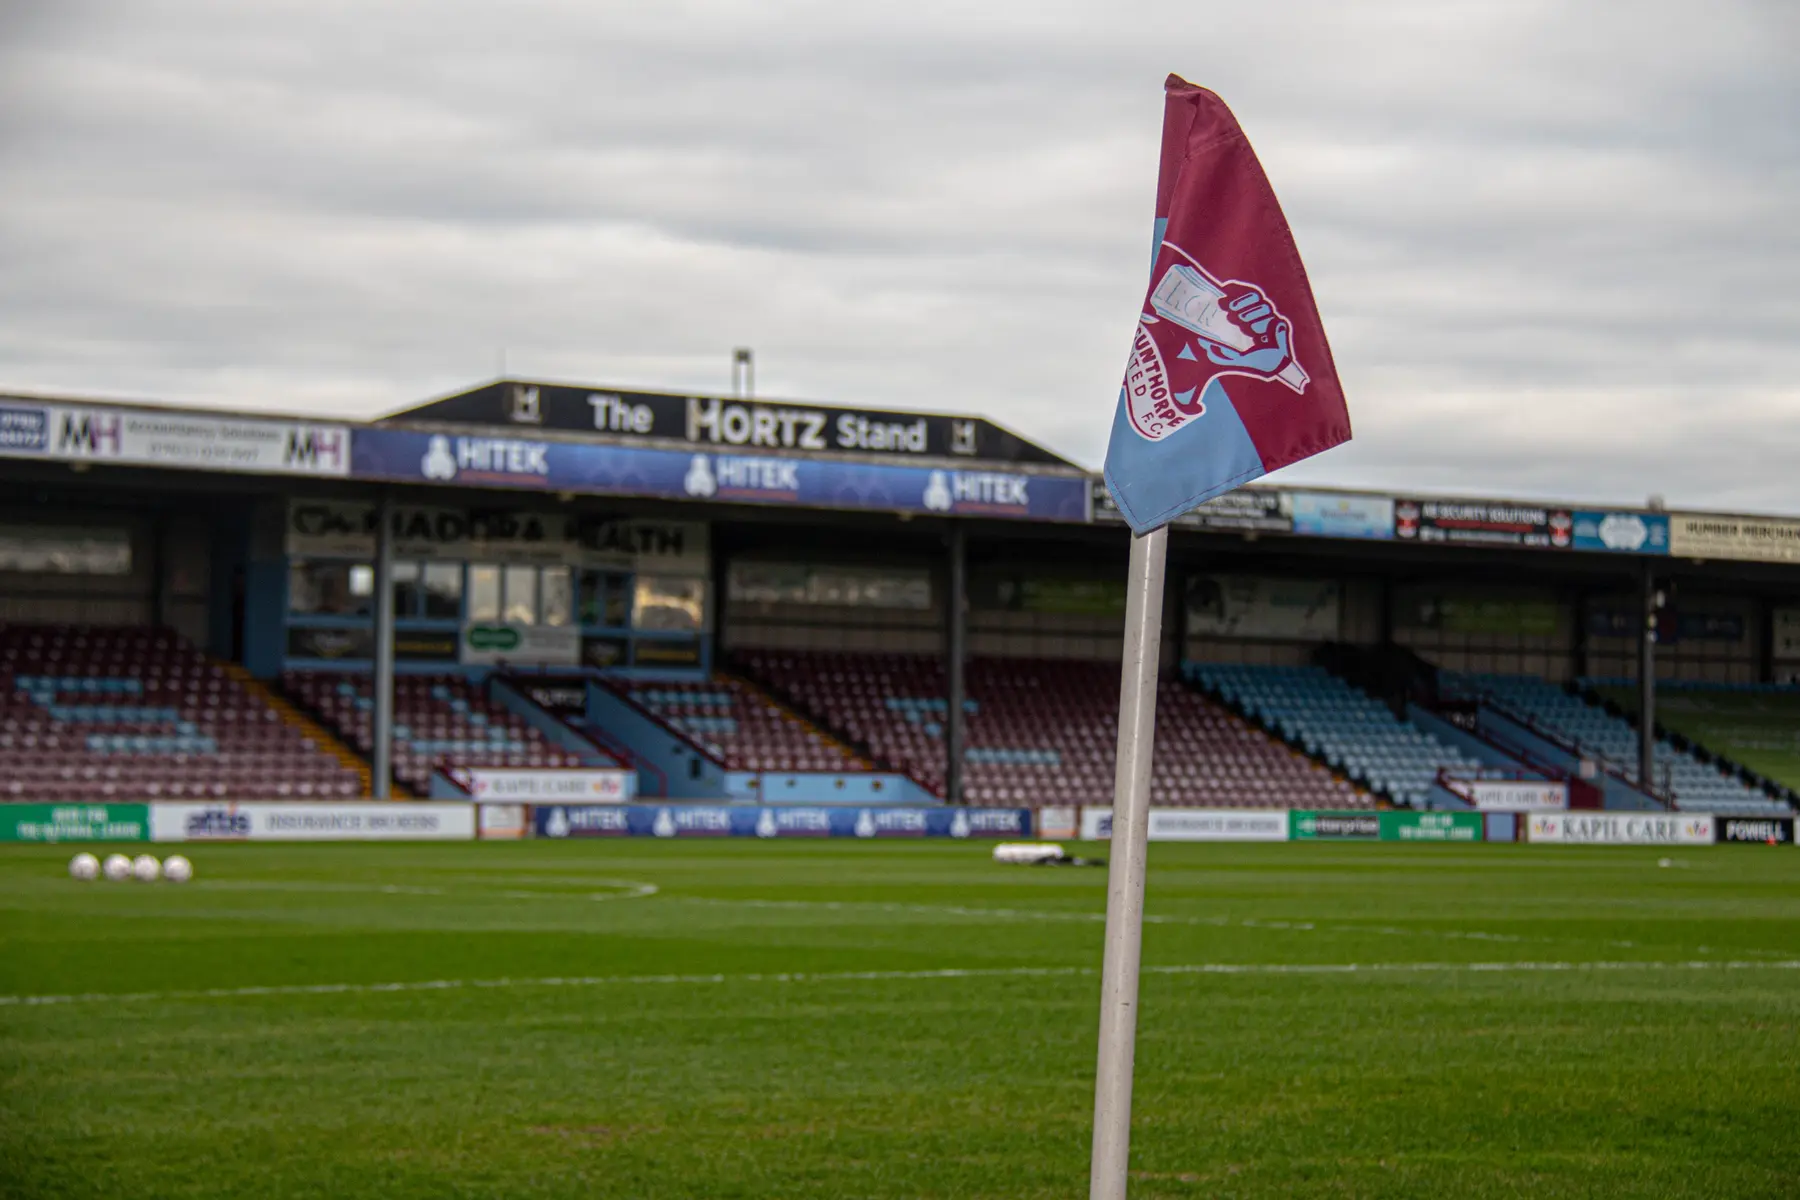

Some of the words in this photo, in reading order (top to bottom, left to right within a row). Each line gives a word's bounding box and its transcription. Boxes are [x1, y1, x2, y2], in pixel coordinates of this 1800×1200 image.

[587, 394, 654, 433] The
[685, 398, 828, 451] HORTZ
[836, 413, 928, 452] Stand
[455, 437, 550, 475] HITEK
[715, 456, 800, 490] HITEK
[952, 471, 1030, 505] HITEK
[1562, 817, 1620, 841] KAPIL
[1625, 817, 1679, 841] CARE
